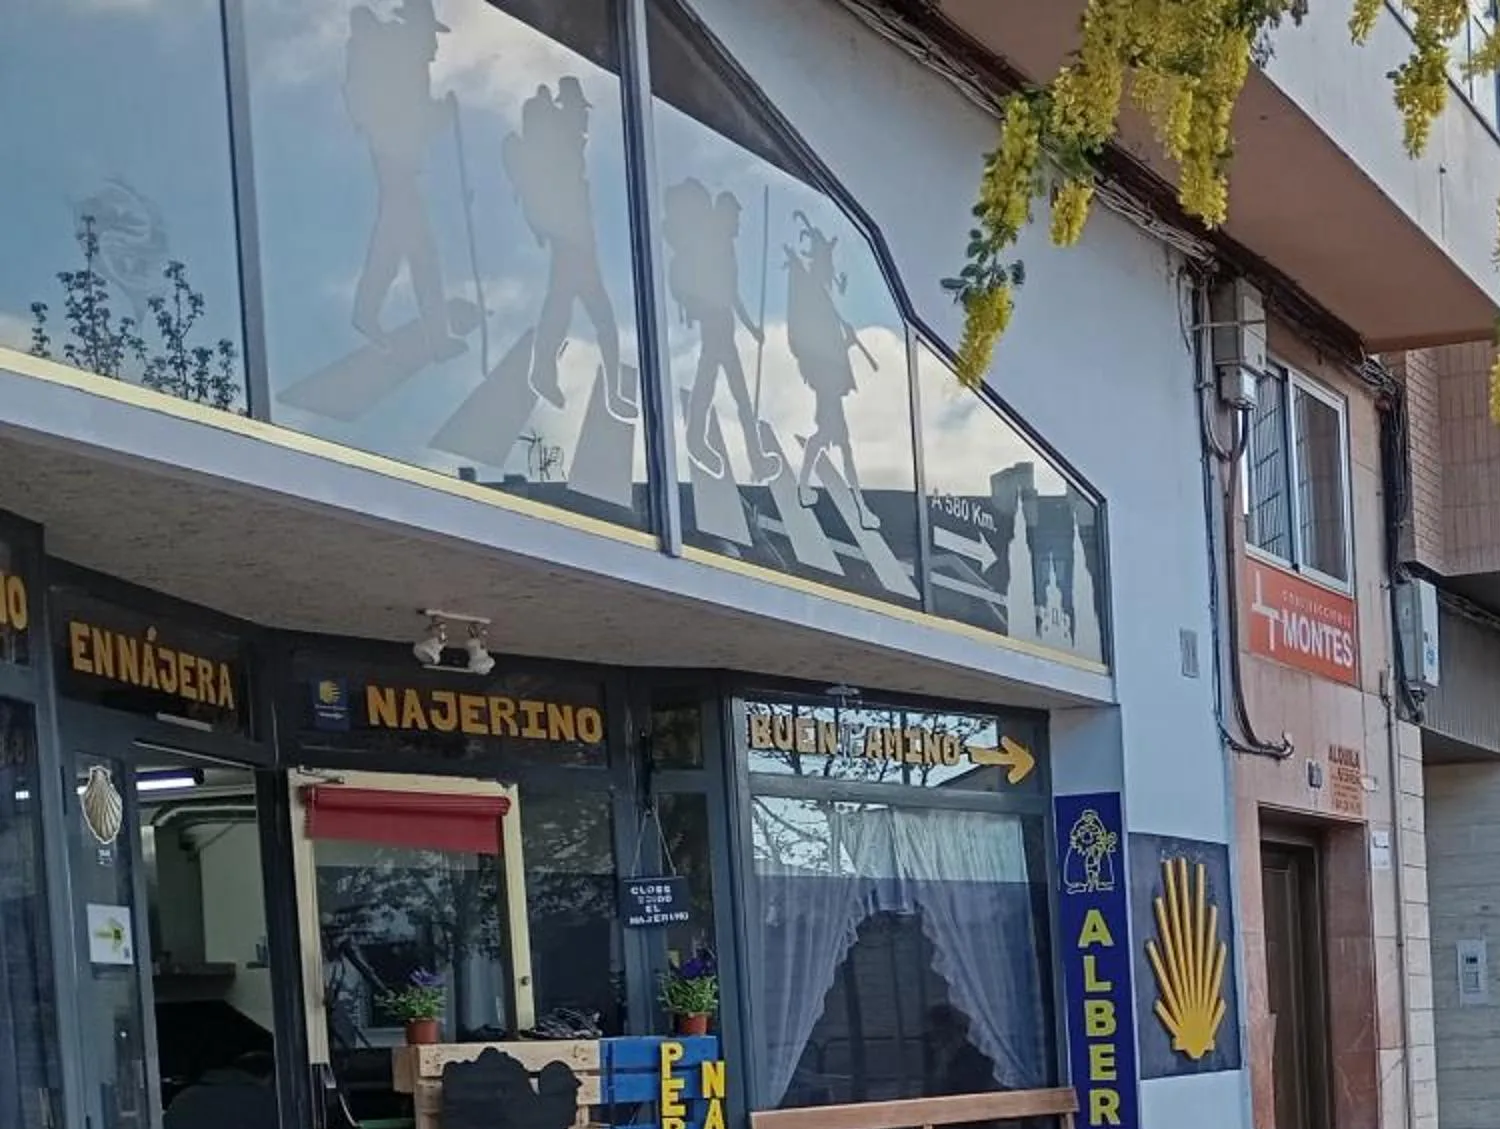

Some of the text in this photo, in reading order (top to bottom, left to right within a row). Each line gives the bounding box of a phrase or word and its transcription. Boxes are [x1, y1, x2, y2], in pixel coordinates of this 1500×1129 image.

[1282, 607, 1353, 668] MONTES
[366, 684, 604, 744] NAJERINO
[749, 713, 839, 756] BUEN
